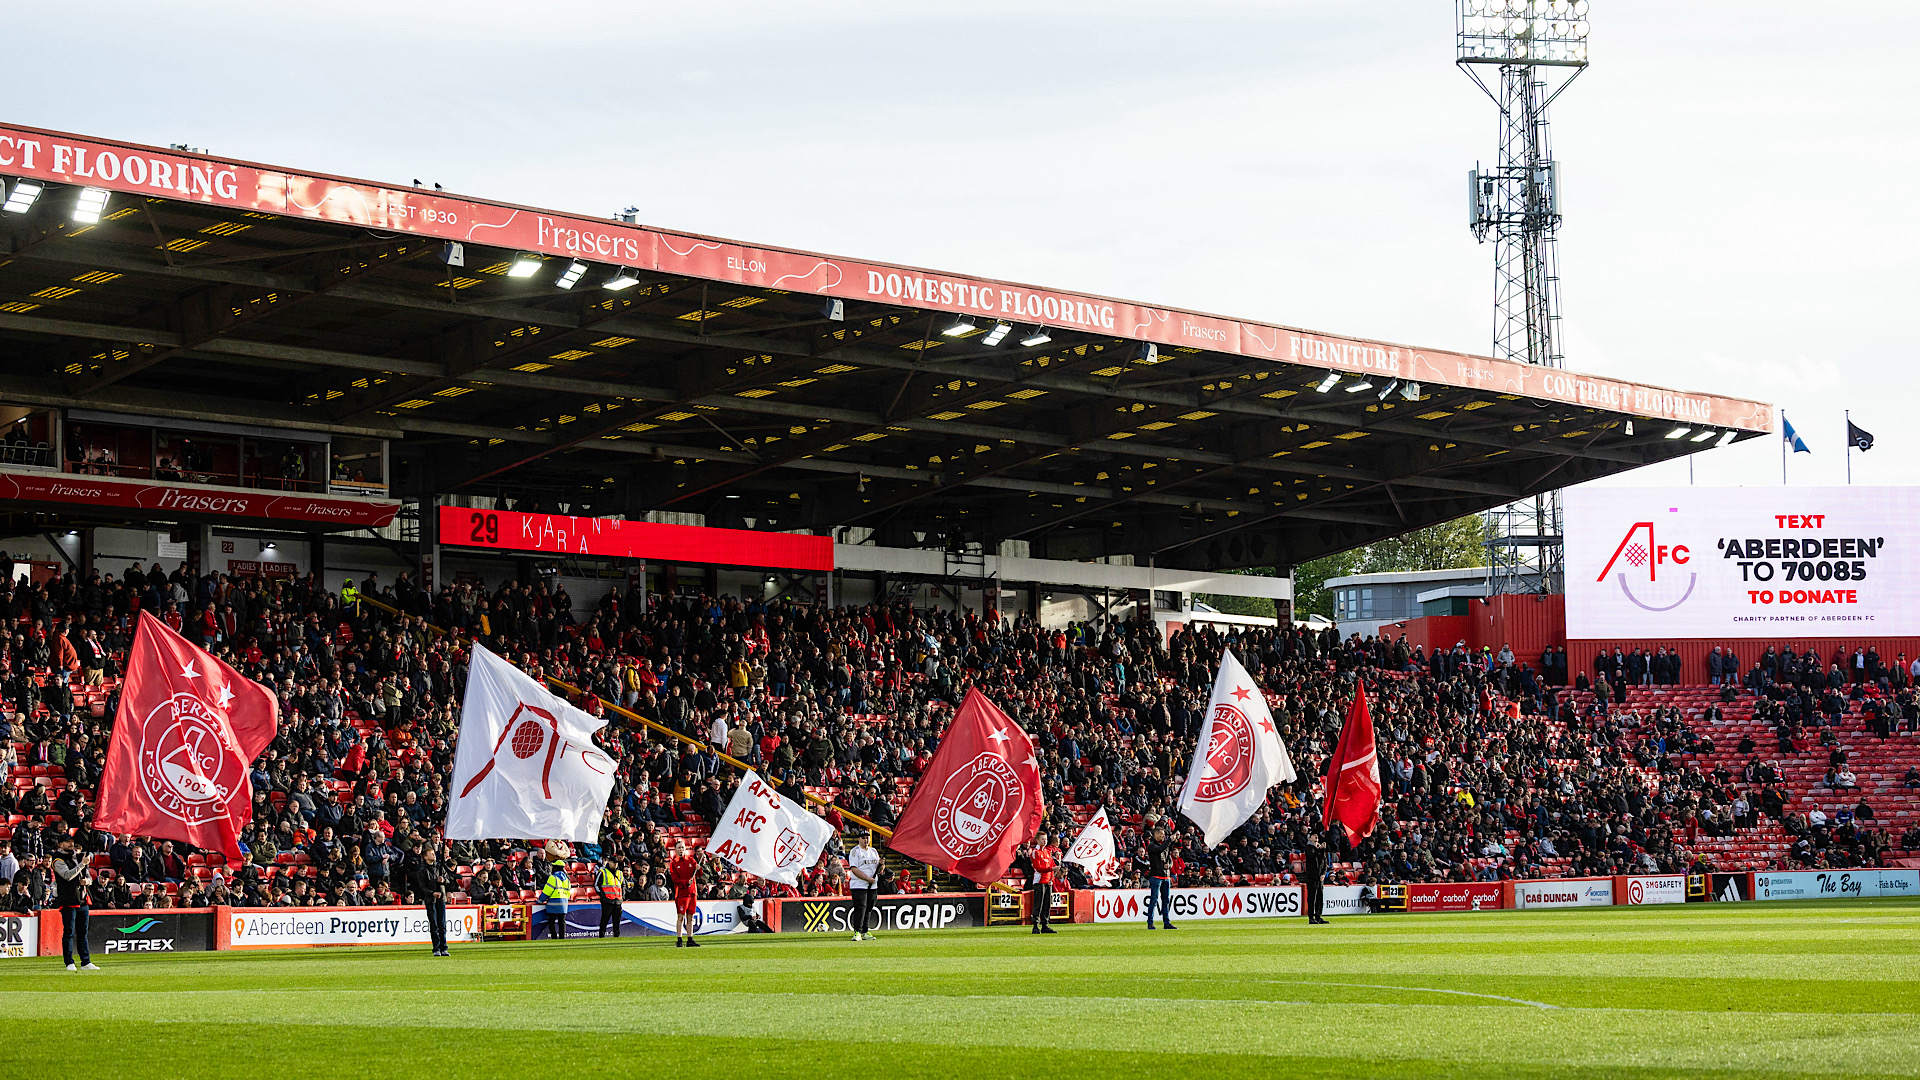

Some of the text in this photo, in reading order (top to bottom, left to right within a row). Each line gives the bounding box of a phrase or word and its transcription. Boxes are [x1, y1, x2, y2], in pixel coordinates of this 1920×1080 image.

[52, 144, 237, 200] FLOORING
[389, 204, 457, 225] EST 1930
[537, 216, 638, 260] Frasers
[727, 256, 766, 274] ELLON
[868, 271, 1115, 330] DOMESTIC FLOORING
[1182, 320, 1226, 342] Frasers
[1290, 336, 1399, 371] FURNITURE
[1457, 362, 1494, 380] Frasers
[1543, 374, 1711, 419] CONTRACT FLOORING
[50, 483, 101, 497] Frasers
[158, 489, 248, 513] Frasers
[305, 503, 352, 516] Frasers
[471, 513, 498, 543] 29
[1775, 515, 1825, 528] TEXT
[222, 543, 233, 552] 22
[233, 562, 257, 571] LADIES
[265, 565, 294, 573] LADIES
[1737, 561, 1866, 581] TO 70085
[1748, 590, 1857, 604] TO DONATE
[1214, 709, 1249, 757] BERDEEN
[1217, 749, 1234, 766] FC
[970, 756, 1019, 796] ABERDEEN
[1202, 778, 1235, 796] CLUB
[734, 808, 766, 834] AFC
[937, 796, 974, 856] FOOTBALL
[961, 820, 982, 835] 1903
[715, 839, 747, 865] AFC
[1390, 888, 1398, 896] 23
[1817, 873, 1861, 896] The Bay
[1879, 880, 1908, 890] Fish & Chips
[1001, 894, 1010, 903] 22
[1053, 893, 1060, 902] 22
[1246, 891, 1299, 914] swes
[1412, 893, 1436, 902] carbon
[1443, 893, 1466, 902] carbon
[1472, 893, 1496, 902] carbon
[1544, 893, 1578, 903] DUNCAN
[500, 908, 511, 919] 21
[707, 913, 732, 923] HCS
[248, 916, 462, 937] Aberdeen Property Leang
[105, 939, 174, 954] PETREX
